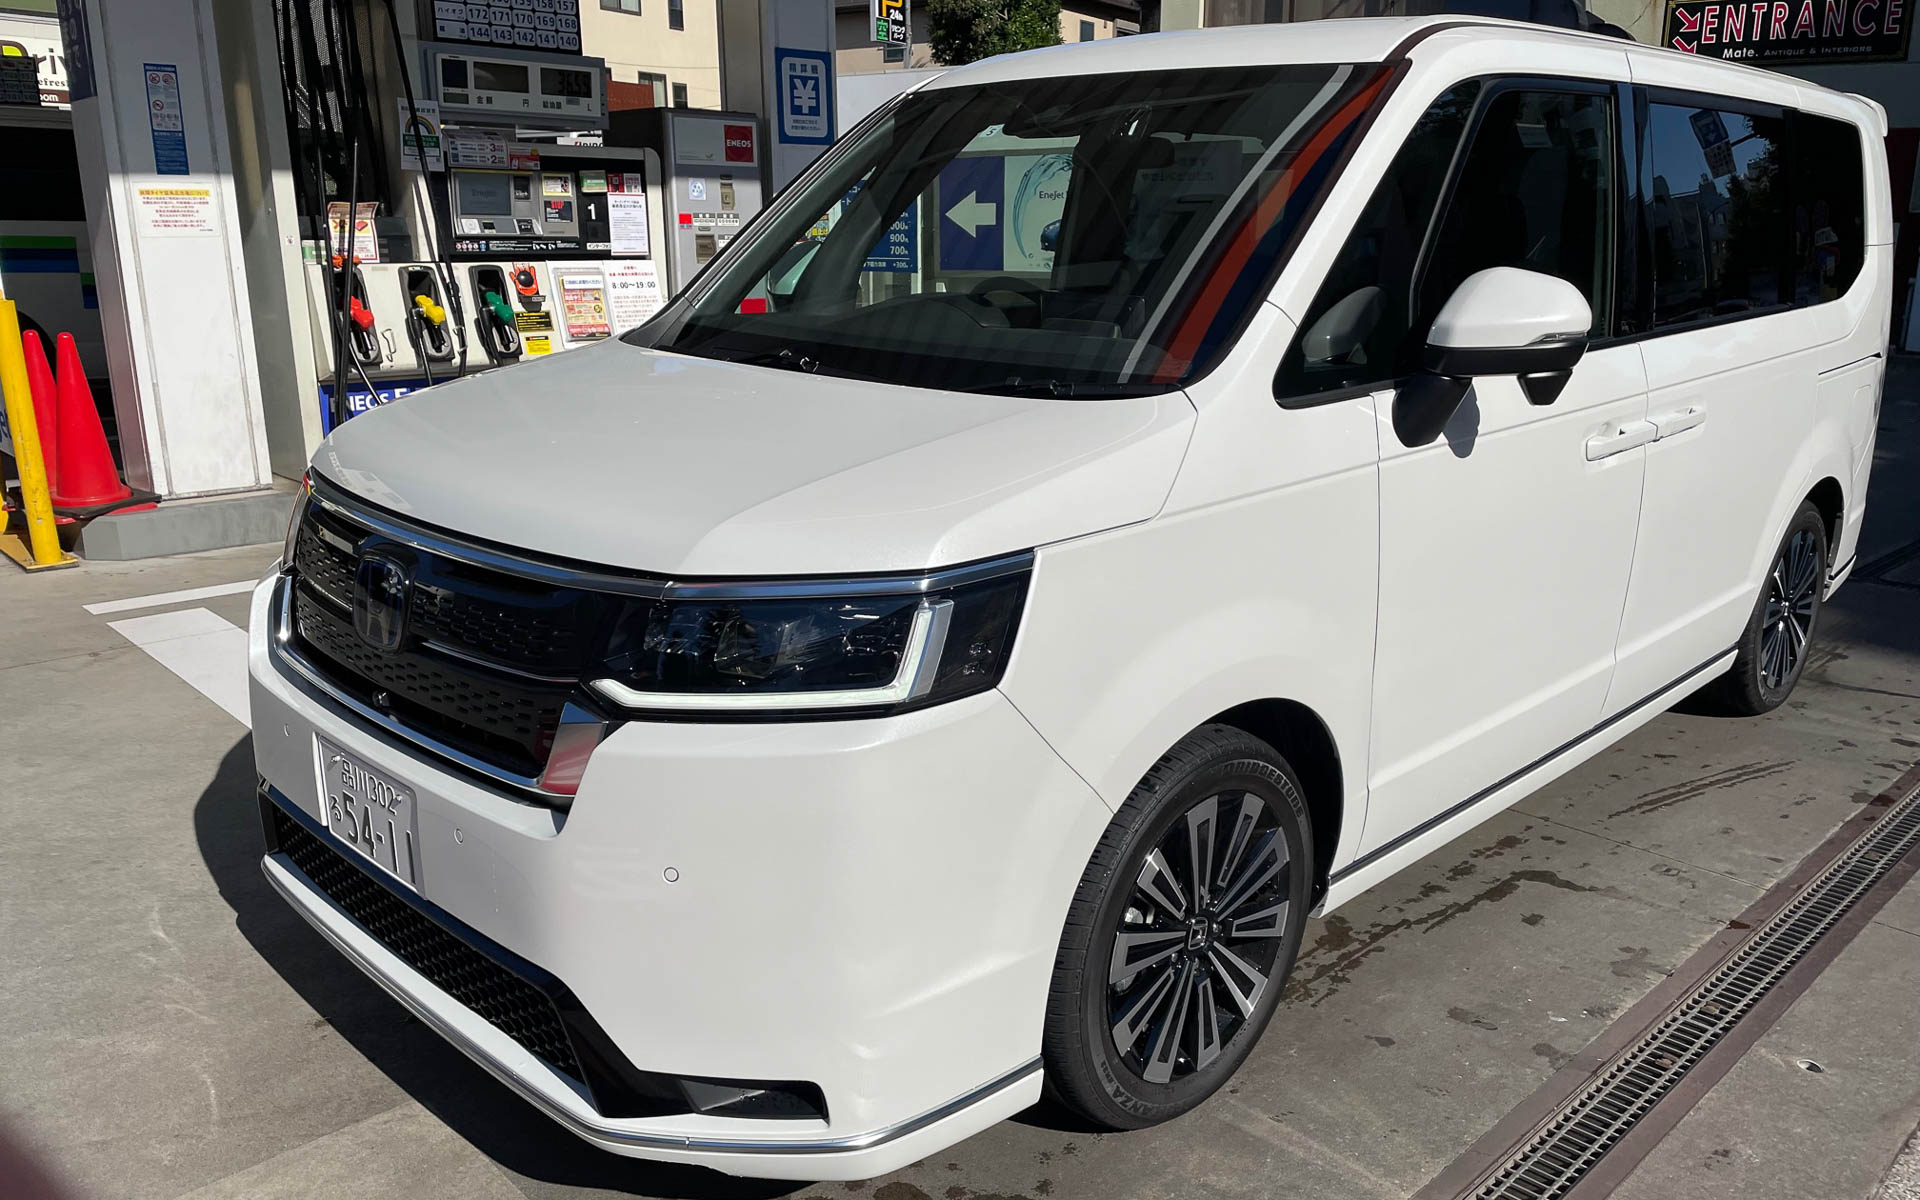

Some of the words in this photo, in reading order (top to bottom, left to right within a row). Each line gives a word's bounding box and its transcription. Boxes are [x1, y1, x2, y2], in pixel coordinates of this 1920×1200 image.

[557, 1, 575, 11] 157
[469, 9, 489, 20] 172
[492, 11, 511, 22] 171
[515, 13, 534, 24] 170
[537, 15, 555, 27] 169
[558, 18, 577, 29] 168
[1701, 0, 1903, 44] ENTRANCE
[470, 27, 490, 38] 144
[494, 29, 513, 41] 143
[517, 31, 535, 43] 142
[537, 33, 556, 45] 141
[559, 35, 577, 47] 140
[1722, 47, 1759, 59] Mate.
[726, 139, 752, 148] ENEOS
[1038, 190, 1064, 201] EneJet
[587, 203, 596, 220] 1
[341, 757, 370, 800] 品川
[369, 775, 397, 816] 302
[342, 789, 416, 885] 54-11
